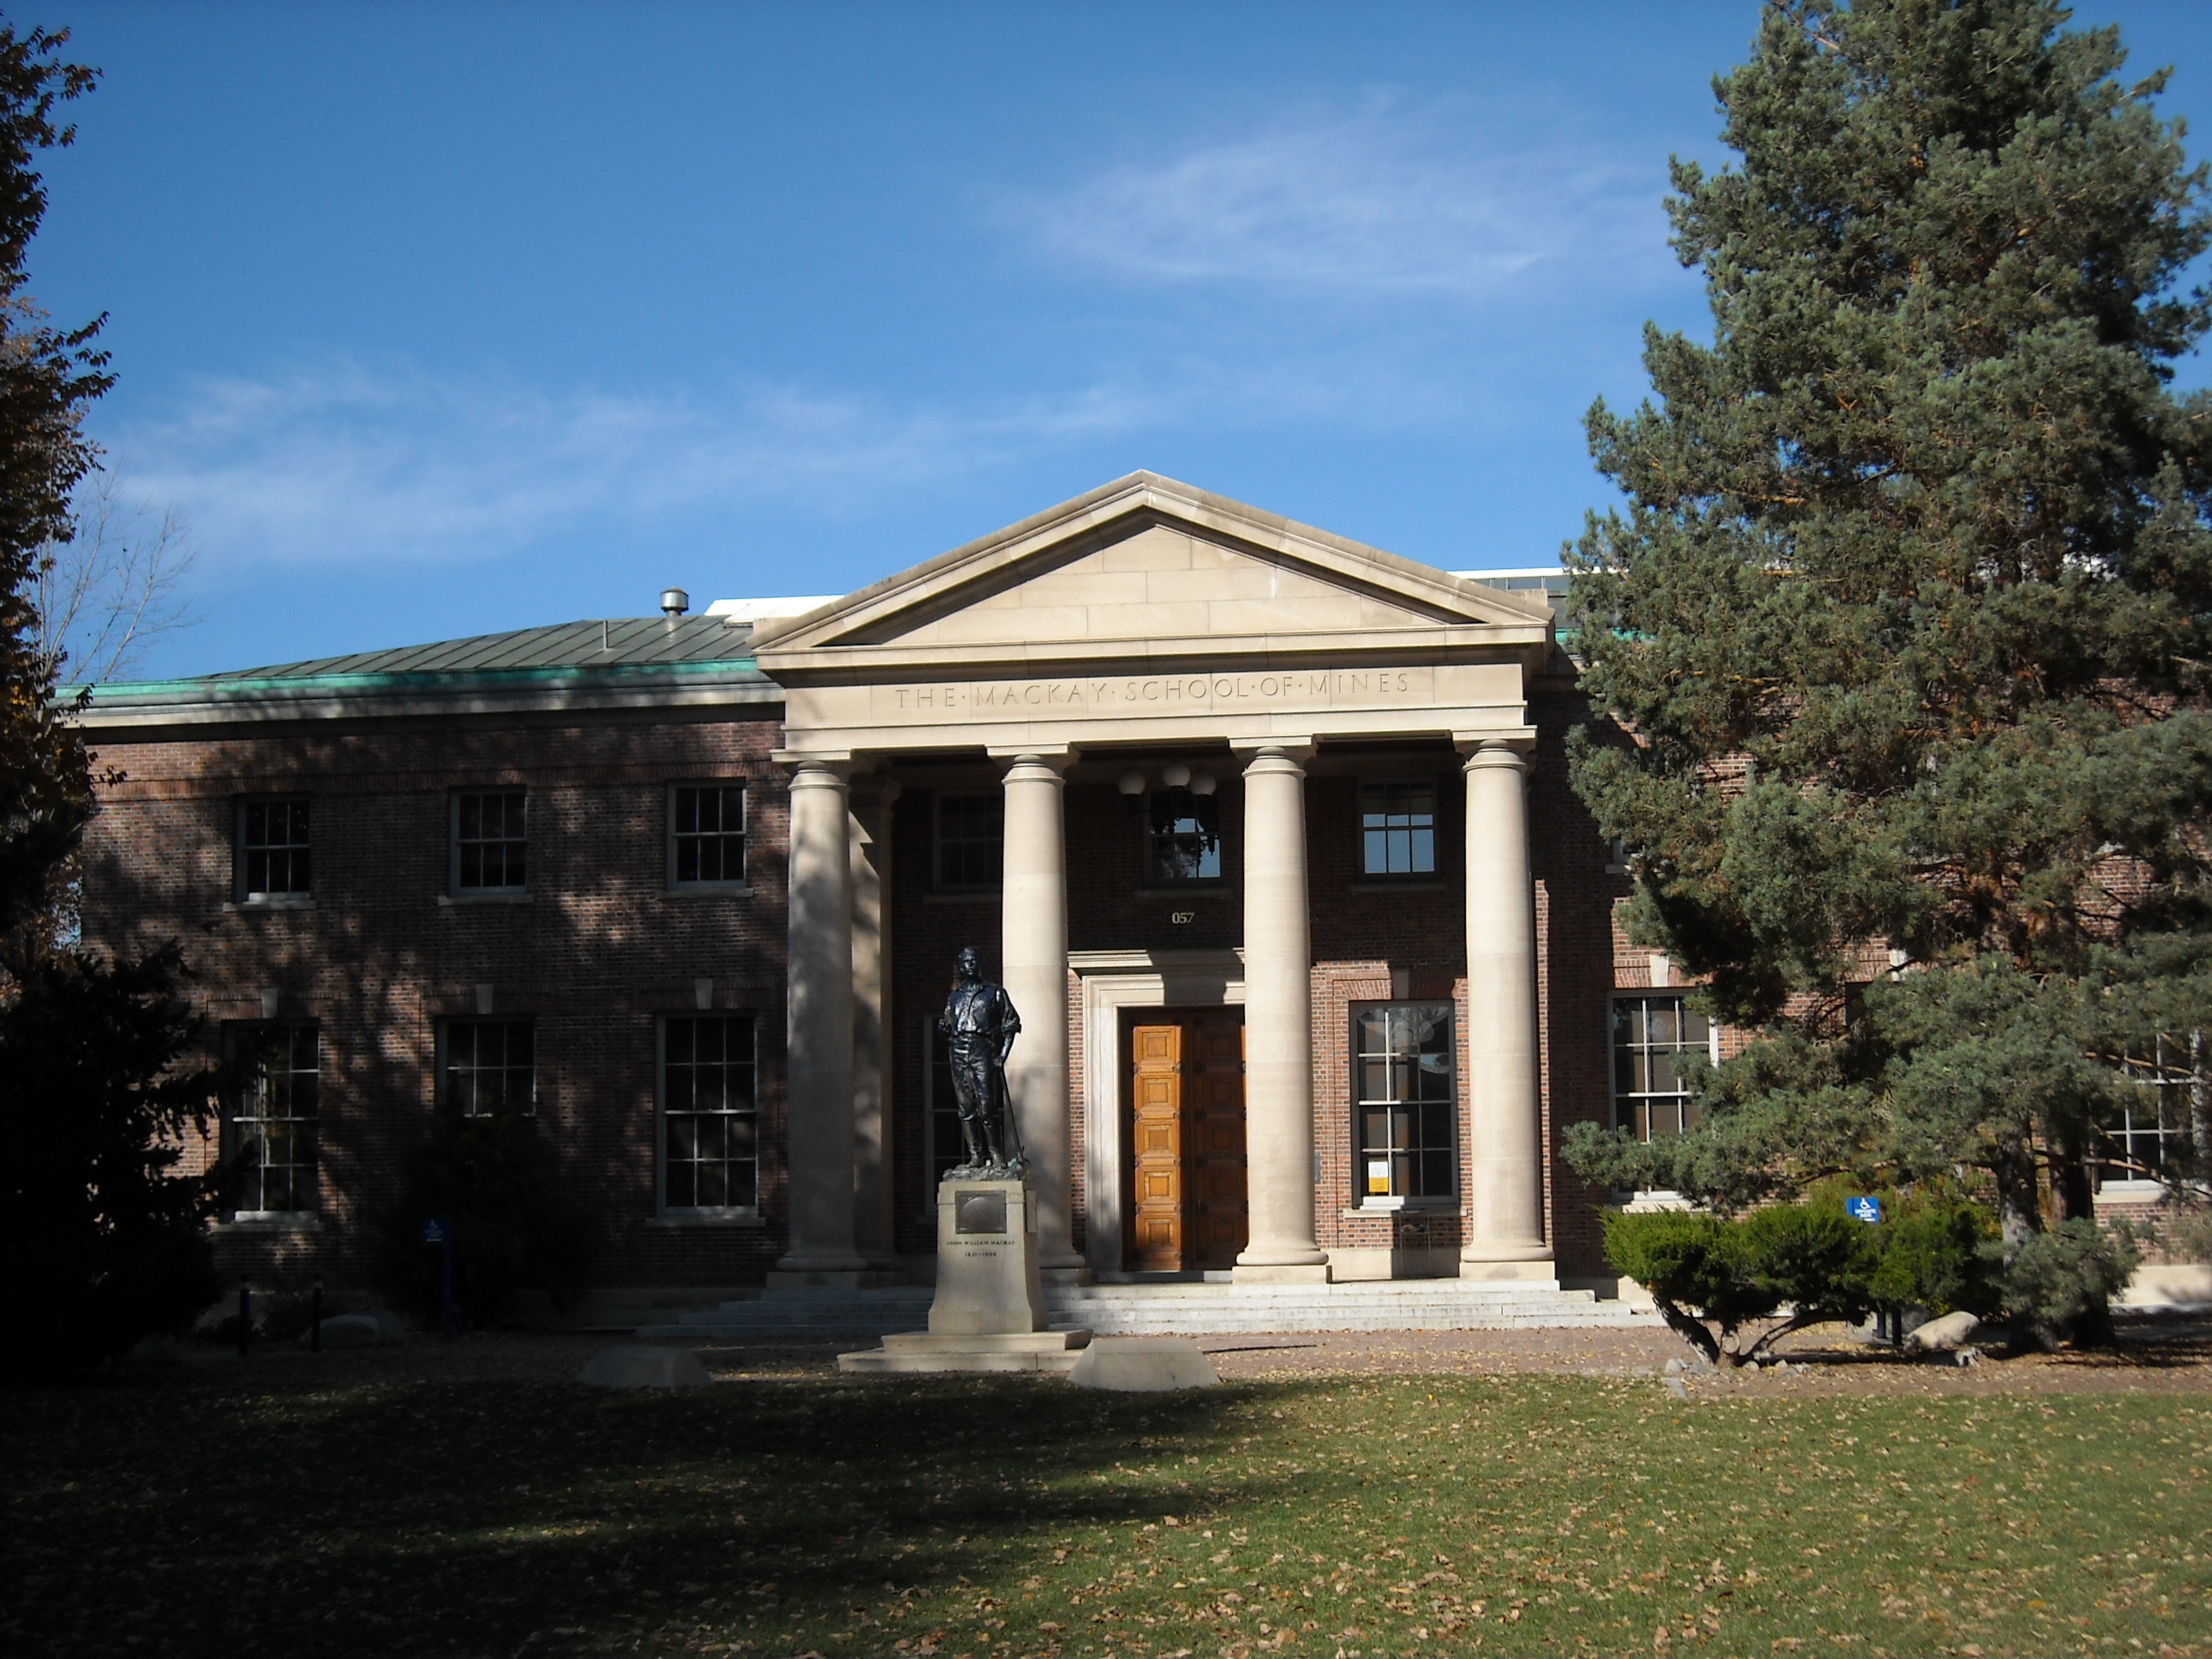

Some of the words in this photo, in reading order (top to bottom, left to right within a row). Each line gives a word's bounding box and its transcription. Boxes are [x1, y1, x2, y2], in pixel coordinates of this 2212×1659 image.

[896, 688, 956, 708] THE
[976, 682, 1107, 707] MACKAY
[1125, 678, 1249, 701] SCHOOL
[1260, 676, 1293, 697] OF
[1310, 672, 1408, 695] MINES
[1172, 912, 1195, 924] 057
